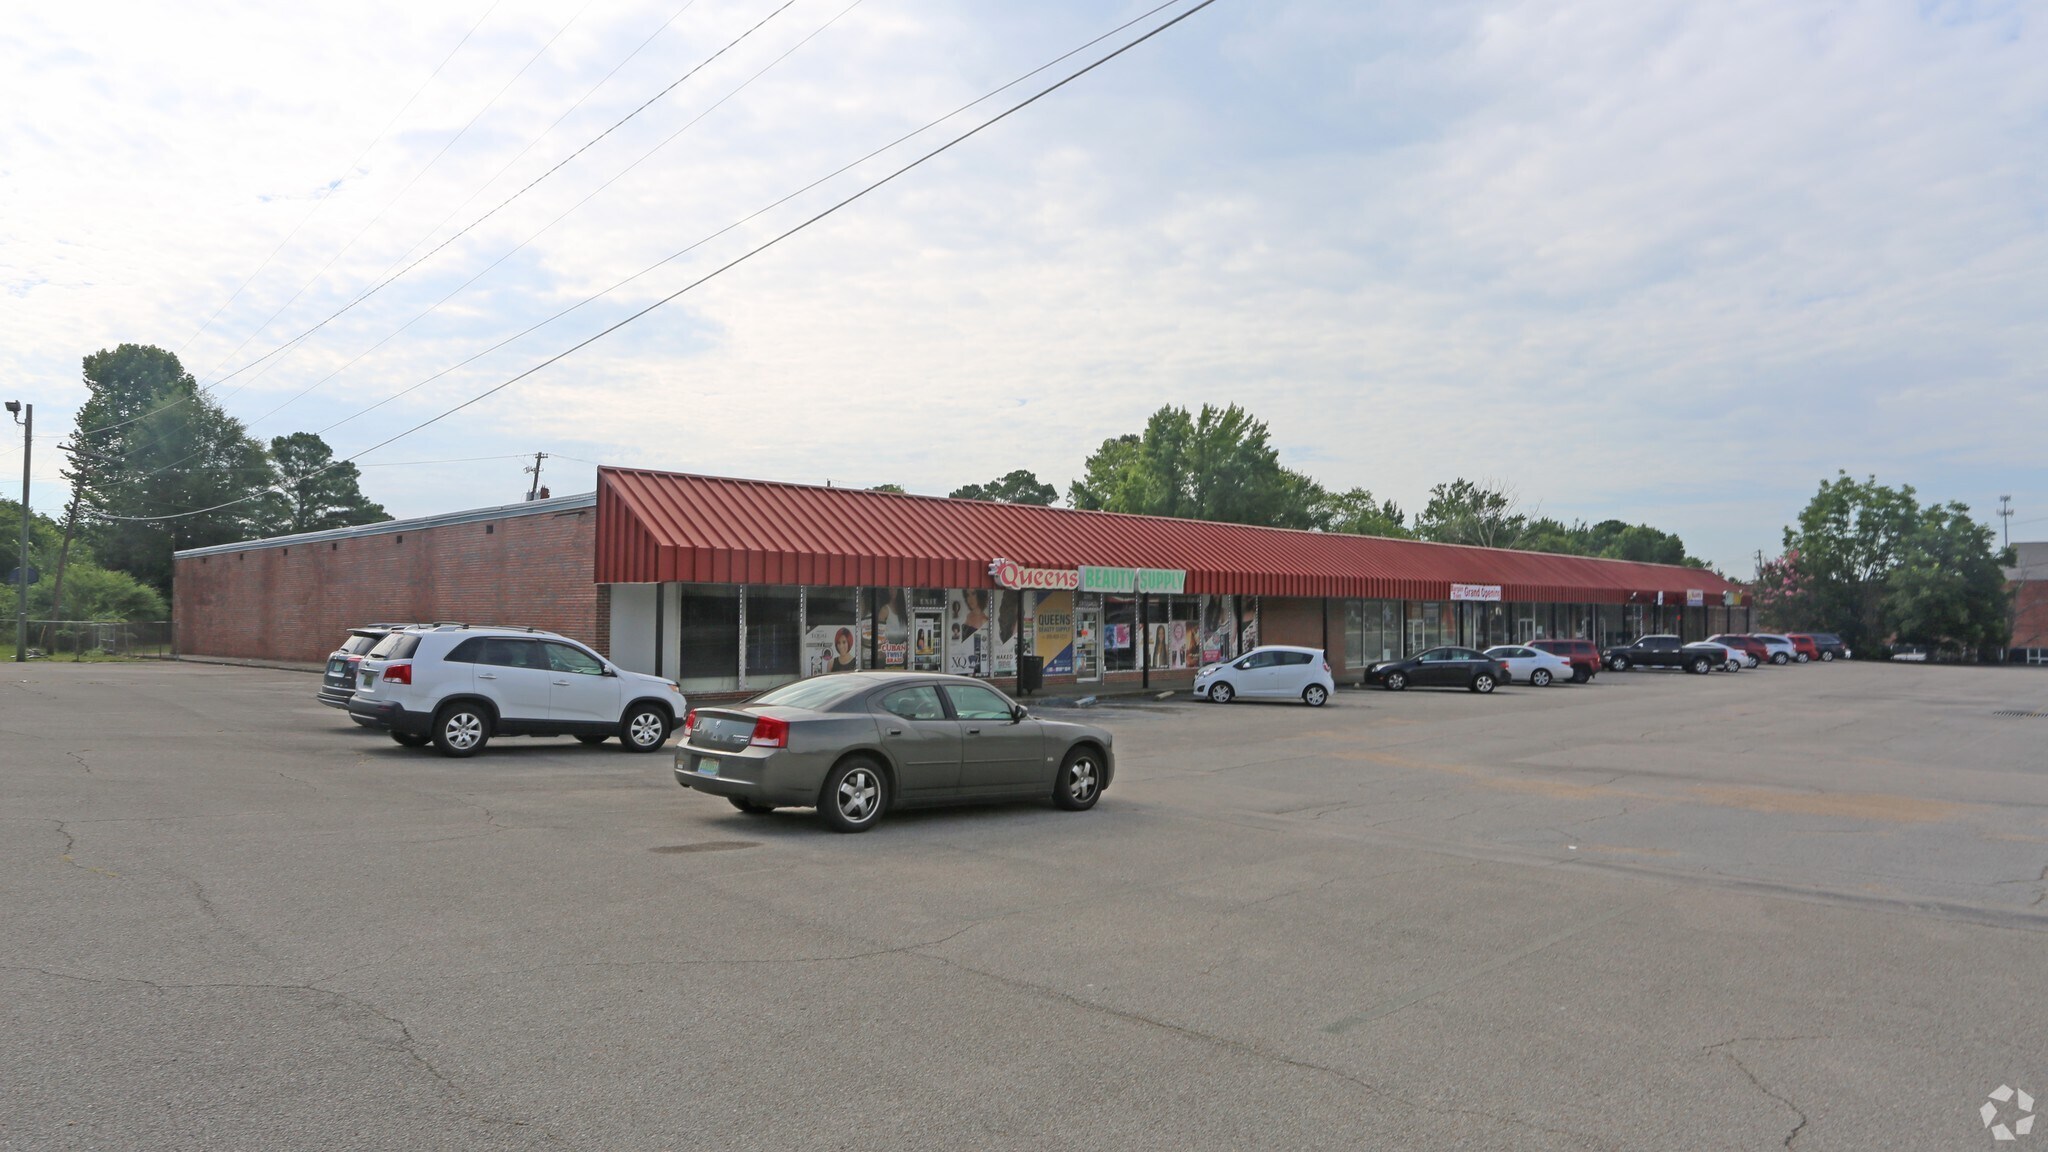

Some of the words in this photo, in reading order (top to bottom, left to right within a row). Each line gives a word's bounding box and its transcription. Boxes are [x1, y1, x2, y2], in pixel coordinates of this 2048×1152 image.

[1001, 563, 1078, 588] Queens
[1085, 569, 1135, 589] BEAUTY
[1138, 569, 1185, 590] SUPPLY
[1464, 586, 1480, 597] Grand
[1481, 587, 1501, 600] Opening
[1038, 614, 1071, 626] QUEENS
[882, 644, 906, 652] CUBAN
